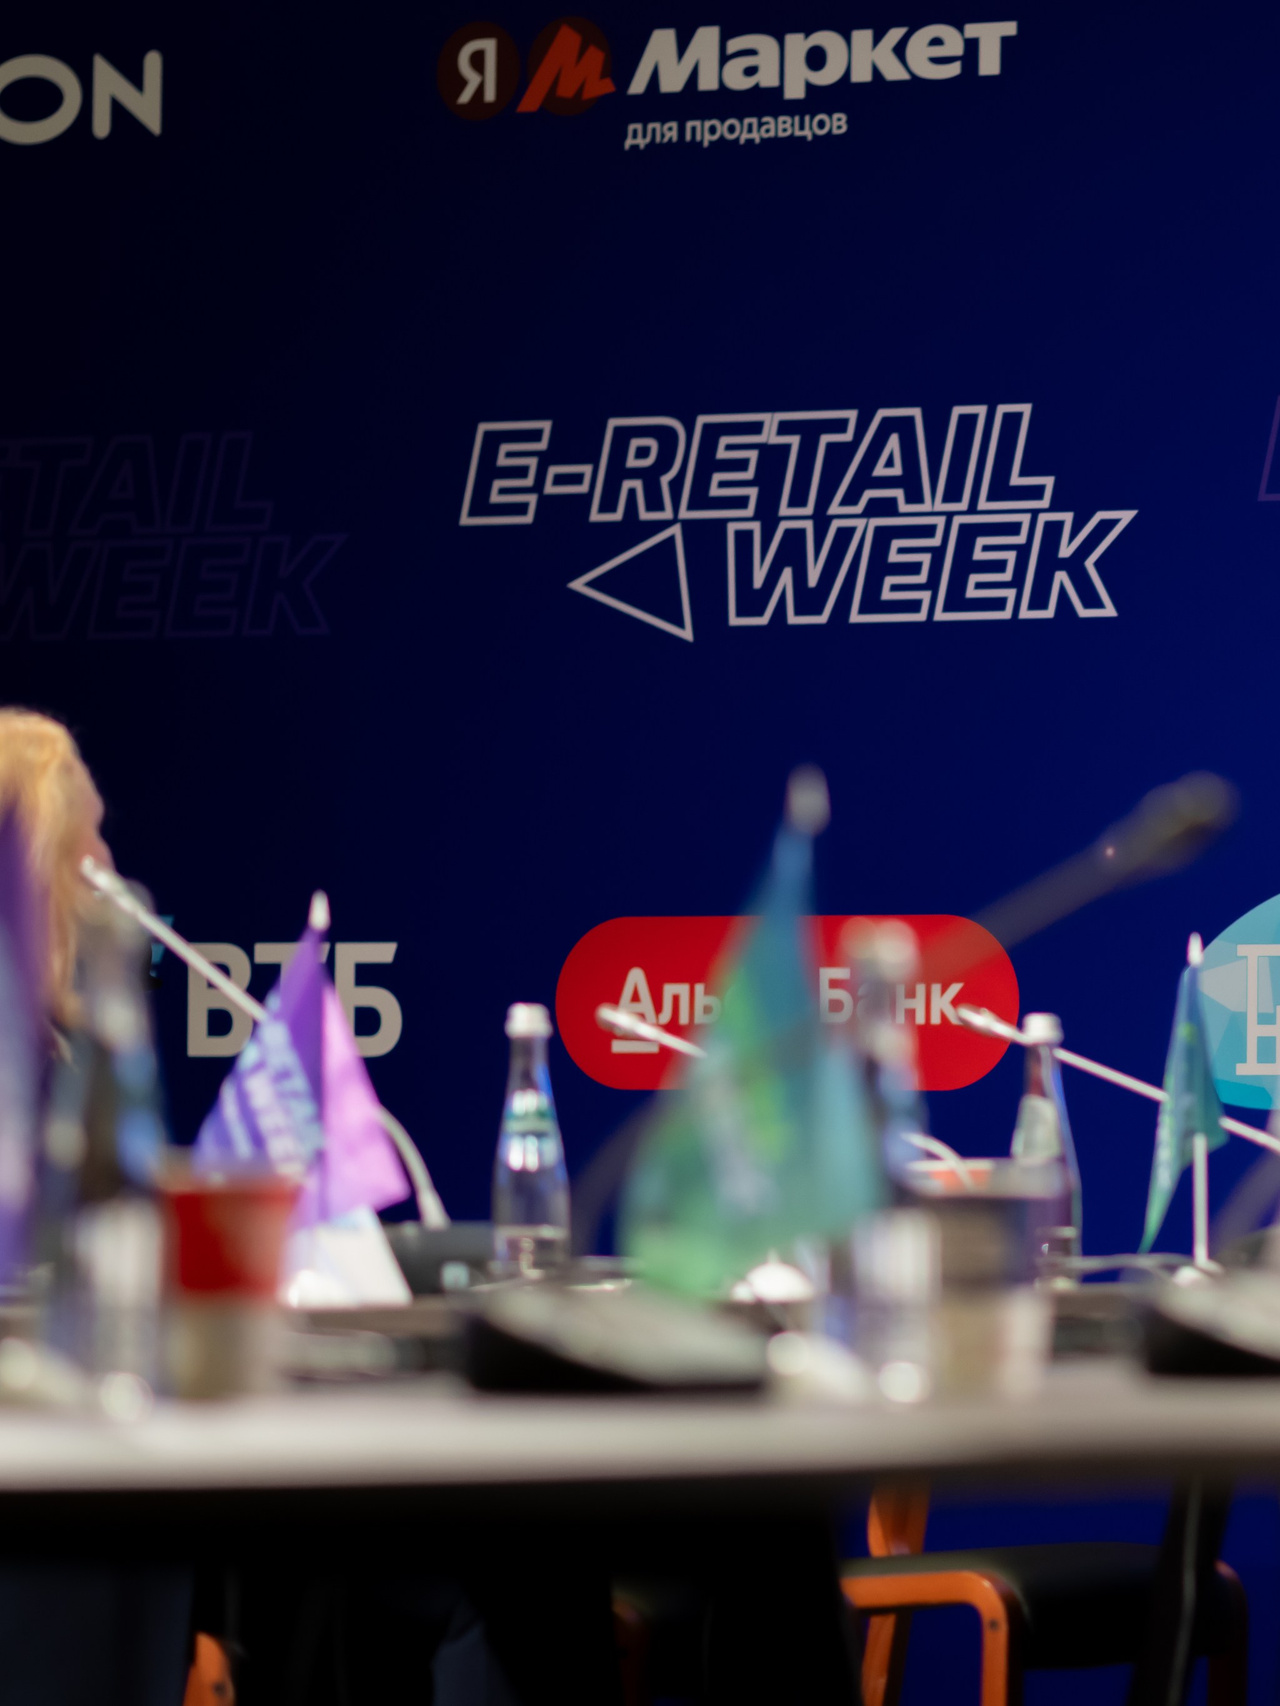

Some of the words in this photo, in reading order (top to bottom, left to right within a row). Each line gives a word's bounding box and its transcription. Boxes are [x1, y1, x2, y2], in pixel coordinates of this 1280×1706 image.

[627, 20, 1018, 100] Маркет
[624, 120, 678, 150] для
[685, 112, 849, 148] продавцов
[0, 431, 274, 538] TAIL
[458, 403, 1056, 526] E-RETAIL
[727, 510, 1139, 626] WEEK
